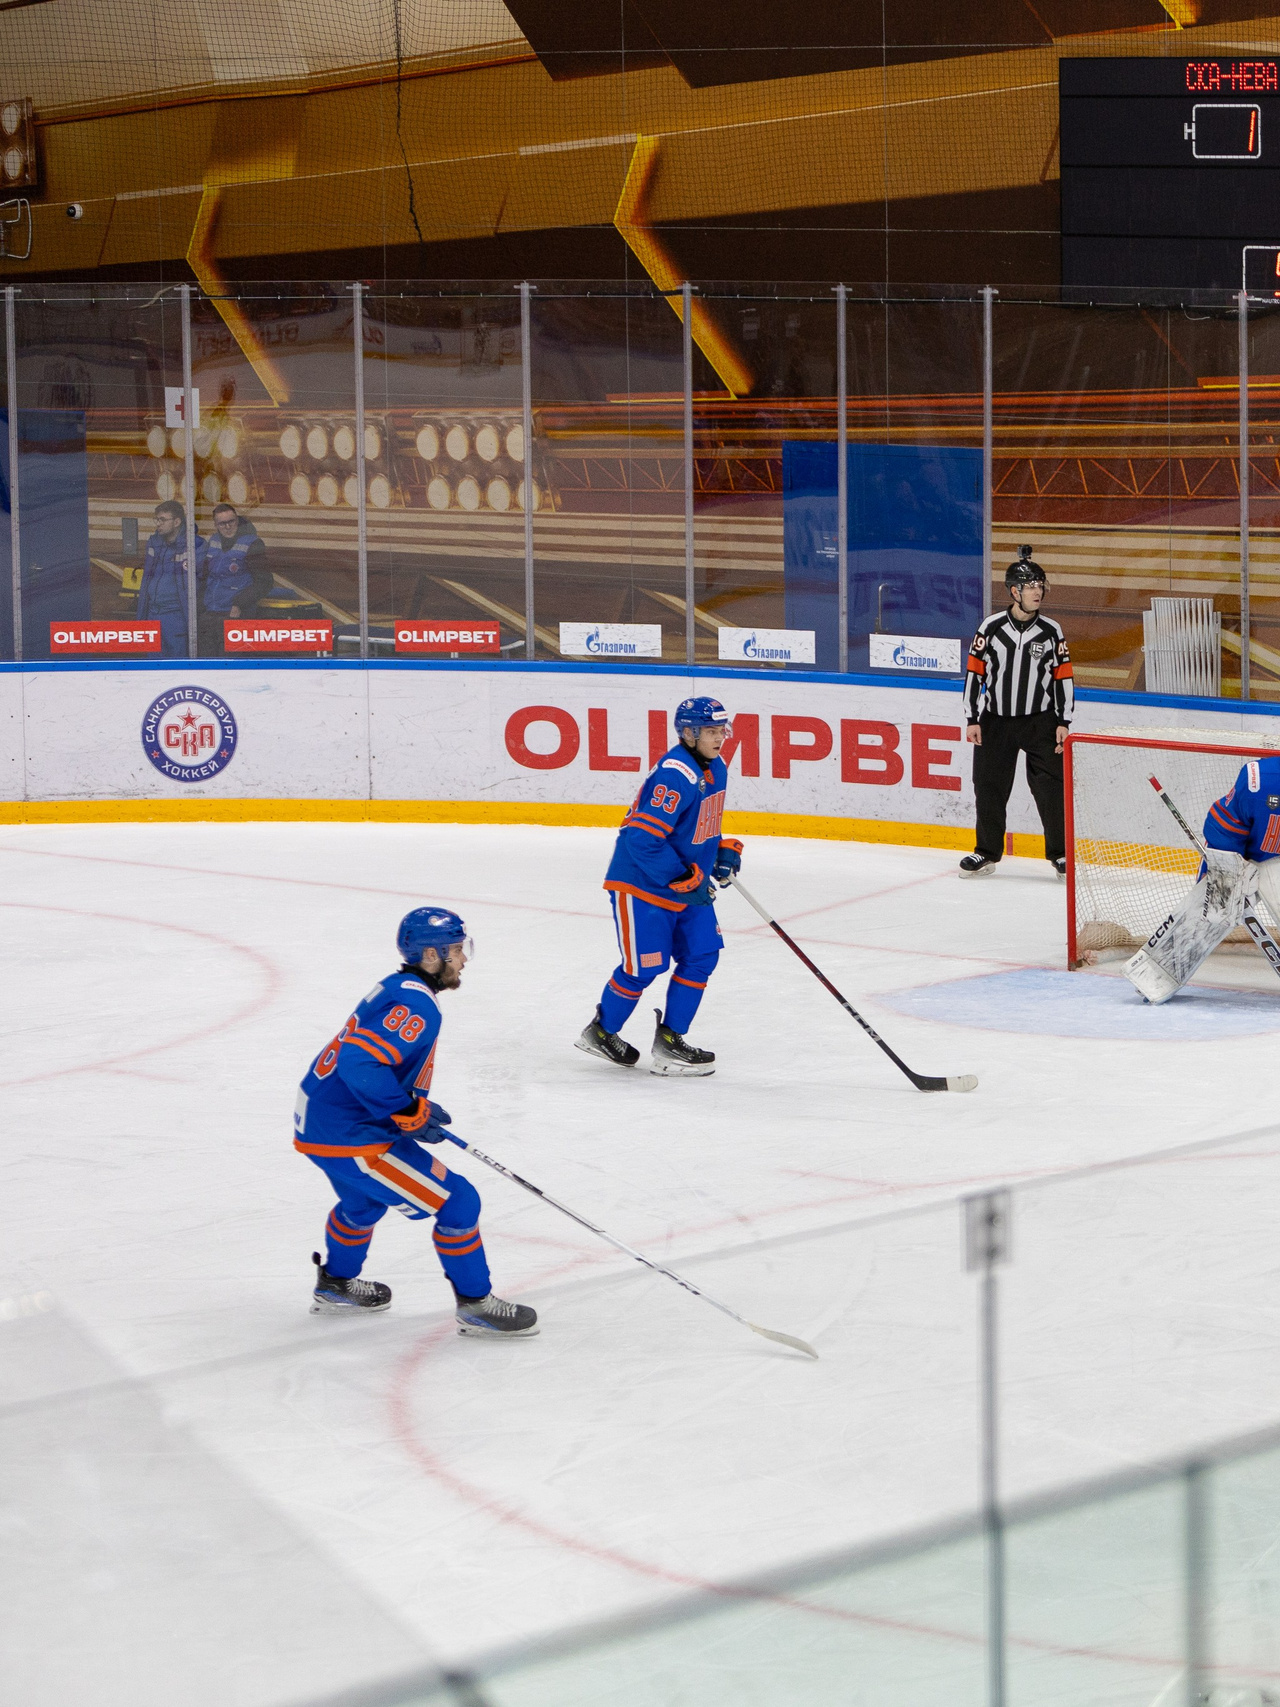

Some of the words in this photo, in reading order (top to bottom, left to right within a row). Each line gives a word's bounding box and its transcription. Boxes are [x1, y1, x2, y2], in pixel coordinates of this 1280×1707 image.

[1186, 62, 1278, 90] СКА-НЕВА
[1247, 110, 1256, 152] 1
[53, 630, 158, 644] OLIMPBET
[227, 629, 329, 643] OLIMPBET
[397, 630, 498, 644] OLIMPBET
[145, 689, 234, 744] САНКТ-ПЕТЕРБУРГ
[164, 723, 216, 756] СКА
[161, 760, 220, 779] ХОККЕЙ
[665, 760, 696, 781] OLIMPBET
[651, 784, 681, 814] 93
[1147, 914, 1175, 949] CCM
[382, 1004, 426, 1043] 88
